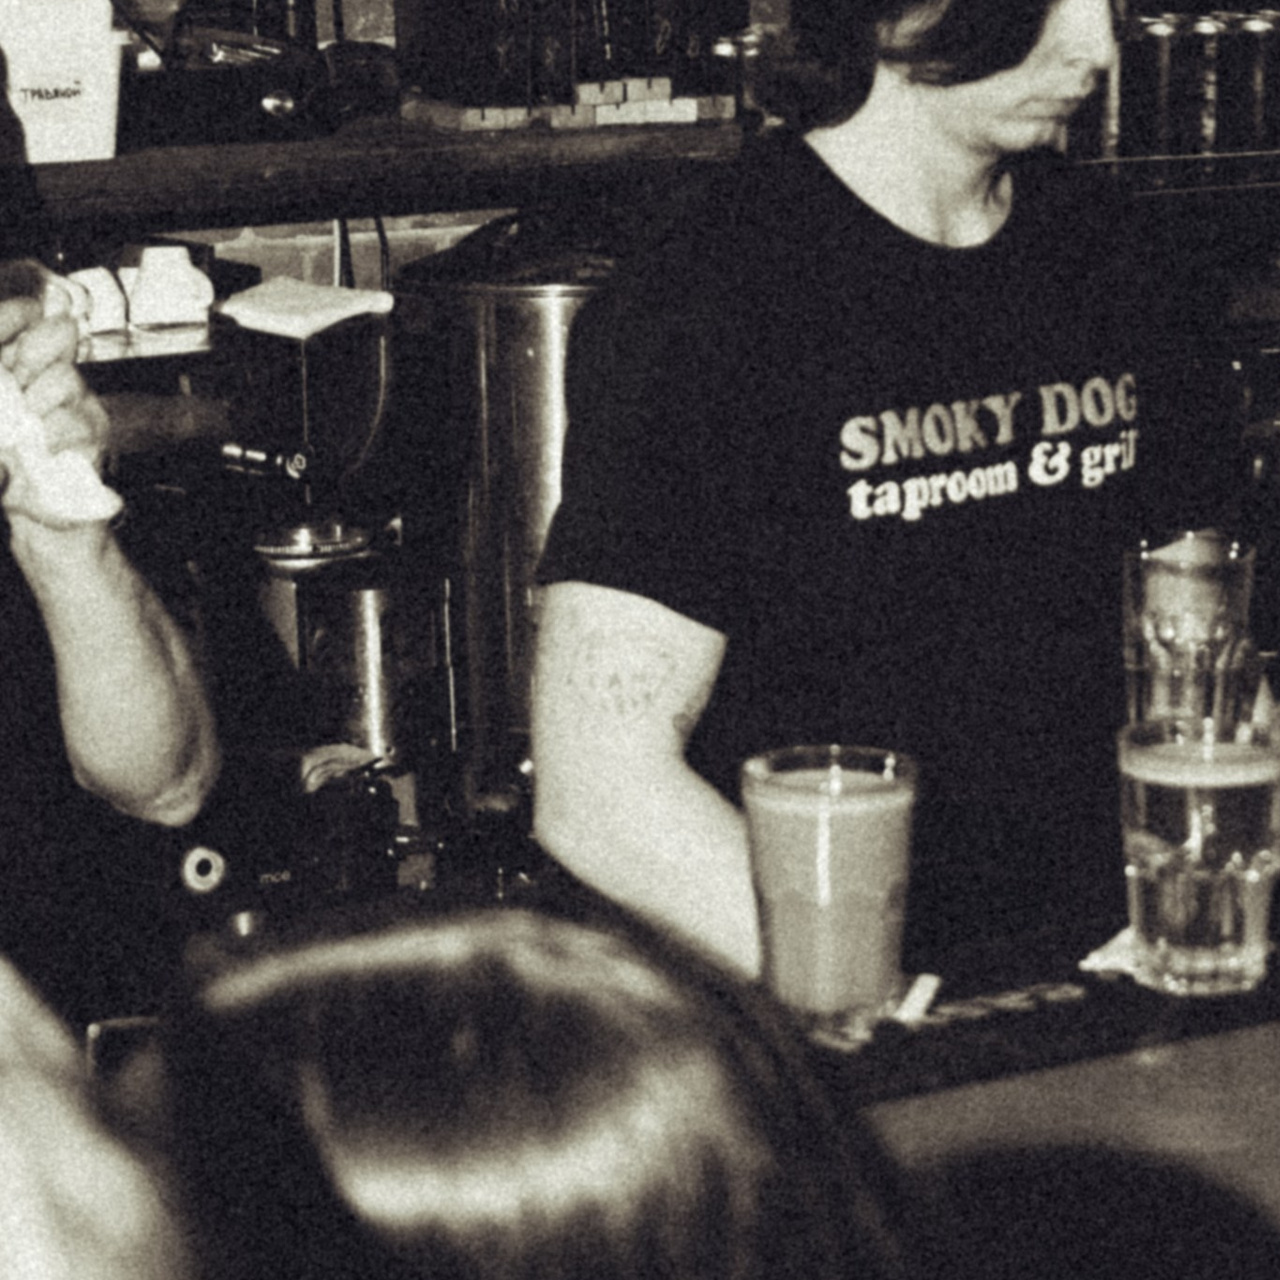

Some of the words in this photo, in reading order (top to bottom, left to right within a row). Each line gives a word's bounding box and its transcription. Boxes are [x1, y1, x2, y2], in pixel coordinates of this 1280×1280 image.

[840, 391, 1022, 471] SMOKY
[1039, 372, 1137, 436] DOG
[846, 460, 1018, 521] taproom
[1028, 440, 1071, 486] &
